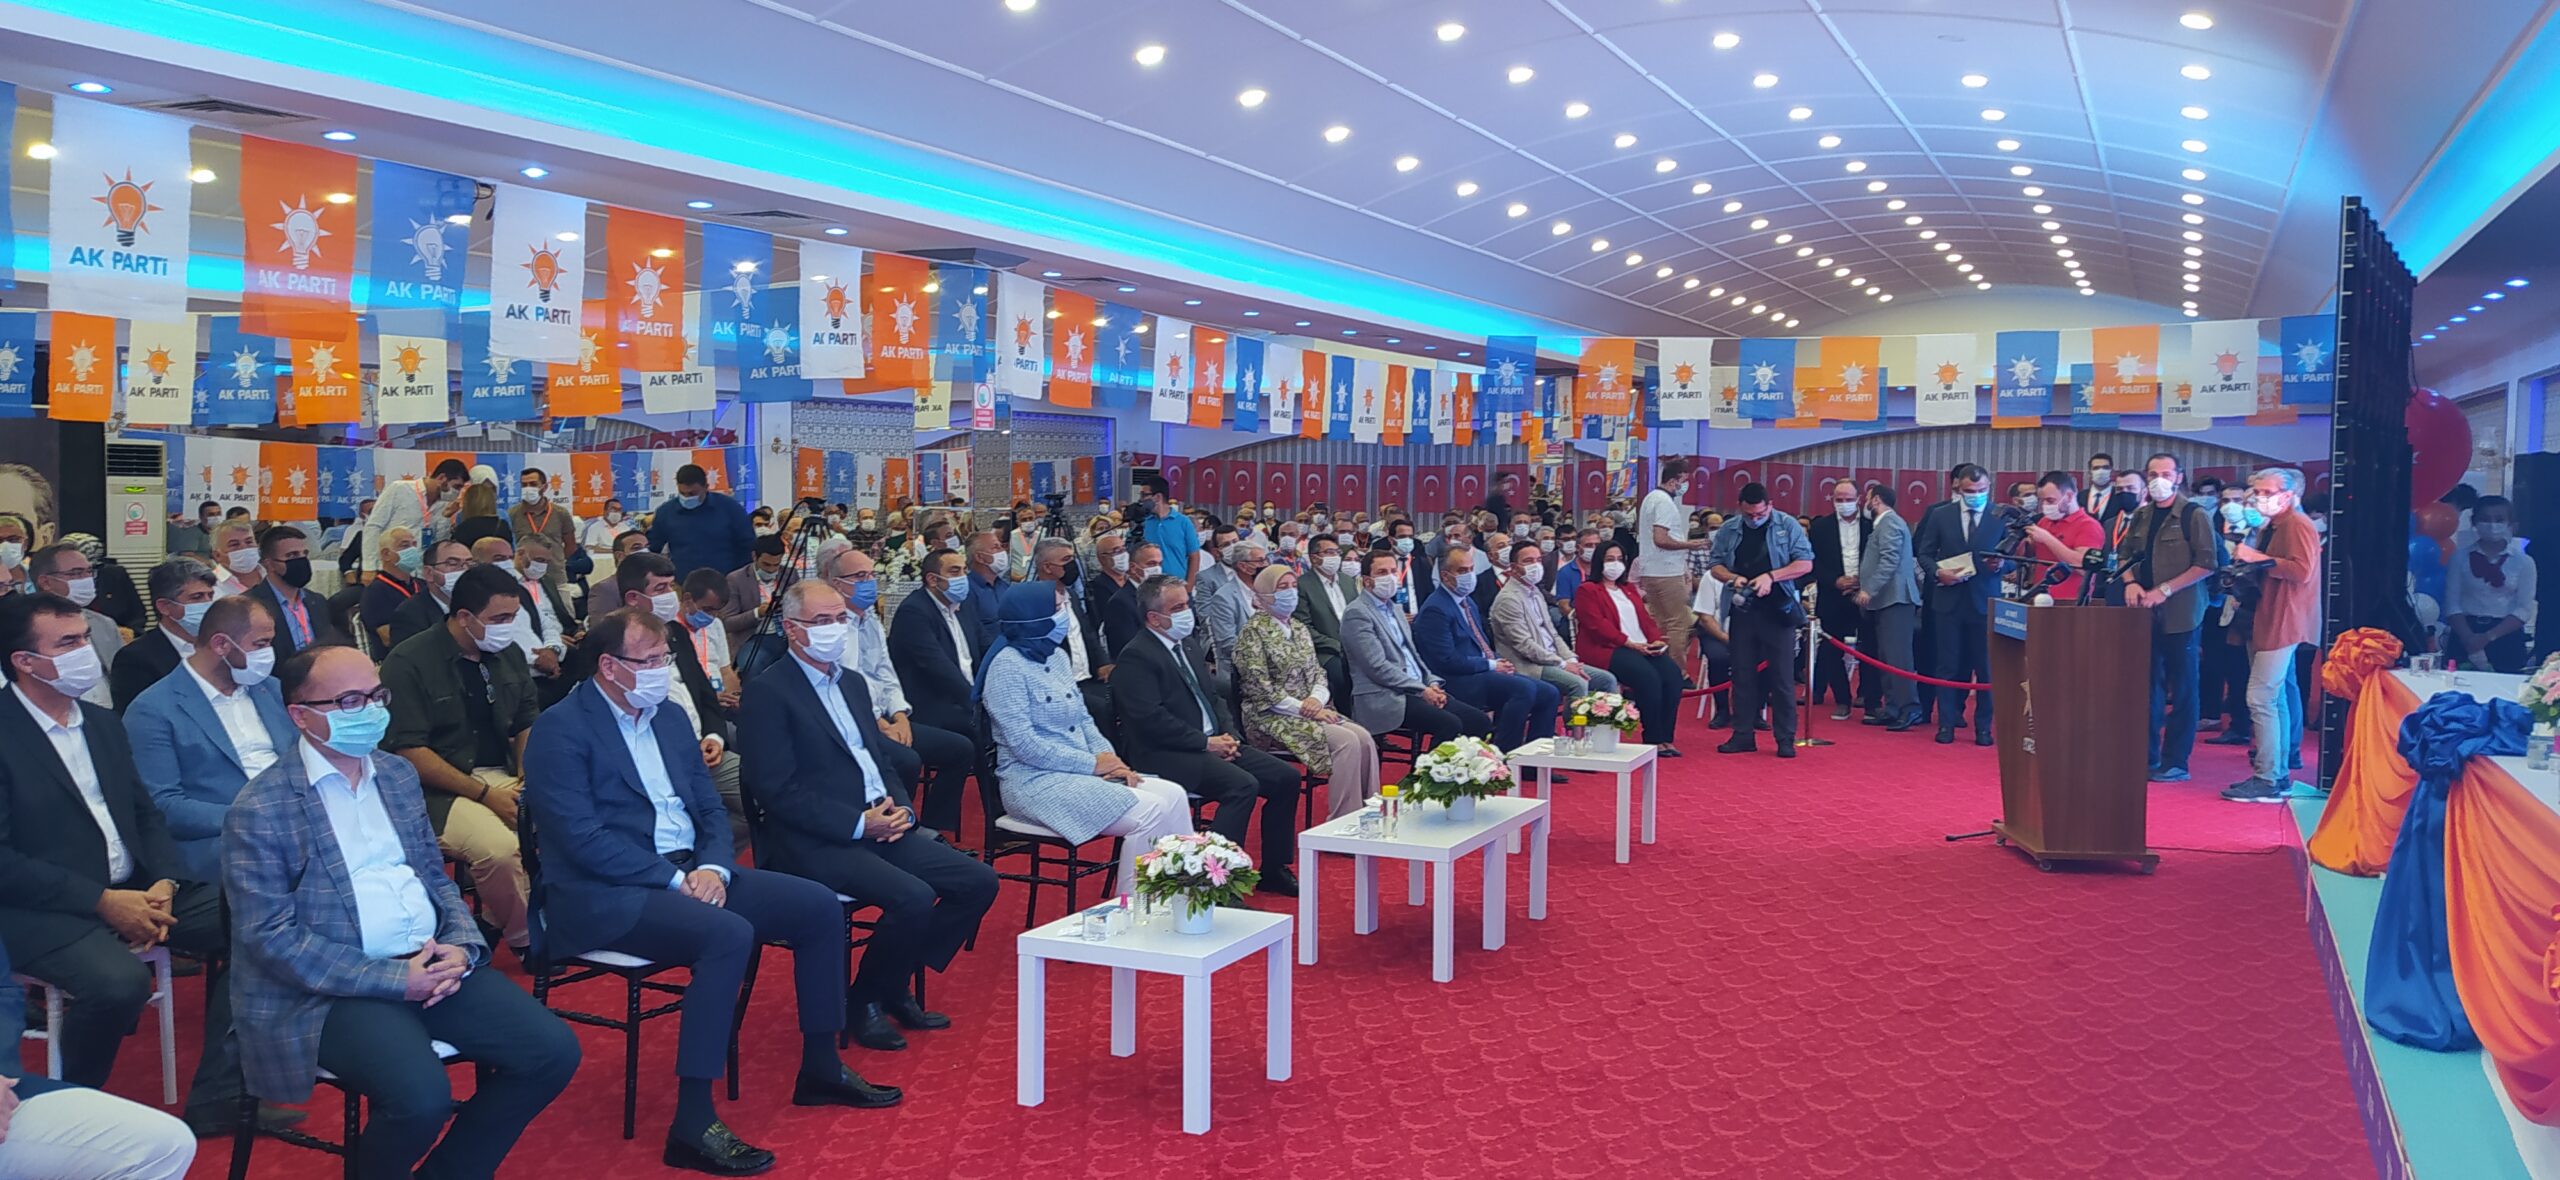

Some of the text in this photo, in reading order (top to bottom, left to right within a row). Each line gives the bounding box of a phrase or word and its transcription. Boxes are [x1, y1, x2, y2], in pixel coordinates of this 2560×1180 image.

[69, 246, 104, 268] AK
[258, 269, 281, 289] AK
[385, 281, 413, 298] AK
[505, 304, 529, 320] AK
[712, 321, 735, 335] AK
[880, 346, 895, 358] AK
[944, 343, 960, 354] AK
[750, 364, 800, 379] AK PART
[555, 376, 574, 387] AK
[650, 376, 667, 386] AK
[2284, 374, 2298, 383] AK
[54, 383, 70, 392] AK
[129, 387, 145, 397] AK
[299, 386, 312, 396] AK
[382, 386, 399, 397] AK
[472, 387, 490, 398] AK
[1487, 386, 1500, 395] AK
[2200, 384, 2216, 393] AK
[218, 389, 234, 400] AK
[1585, 391, 1597, 400] AK
[1662, 391, 1674, 400] AK
[1741, 393, 1754, 401] AK
[1828, 393, 1842, 402] AK
[1924, 393, 1938, 402] AK
[2000, 389, 2014, 398] AK
